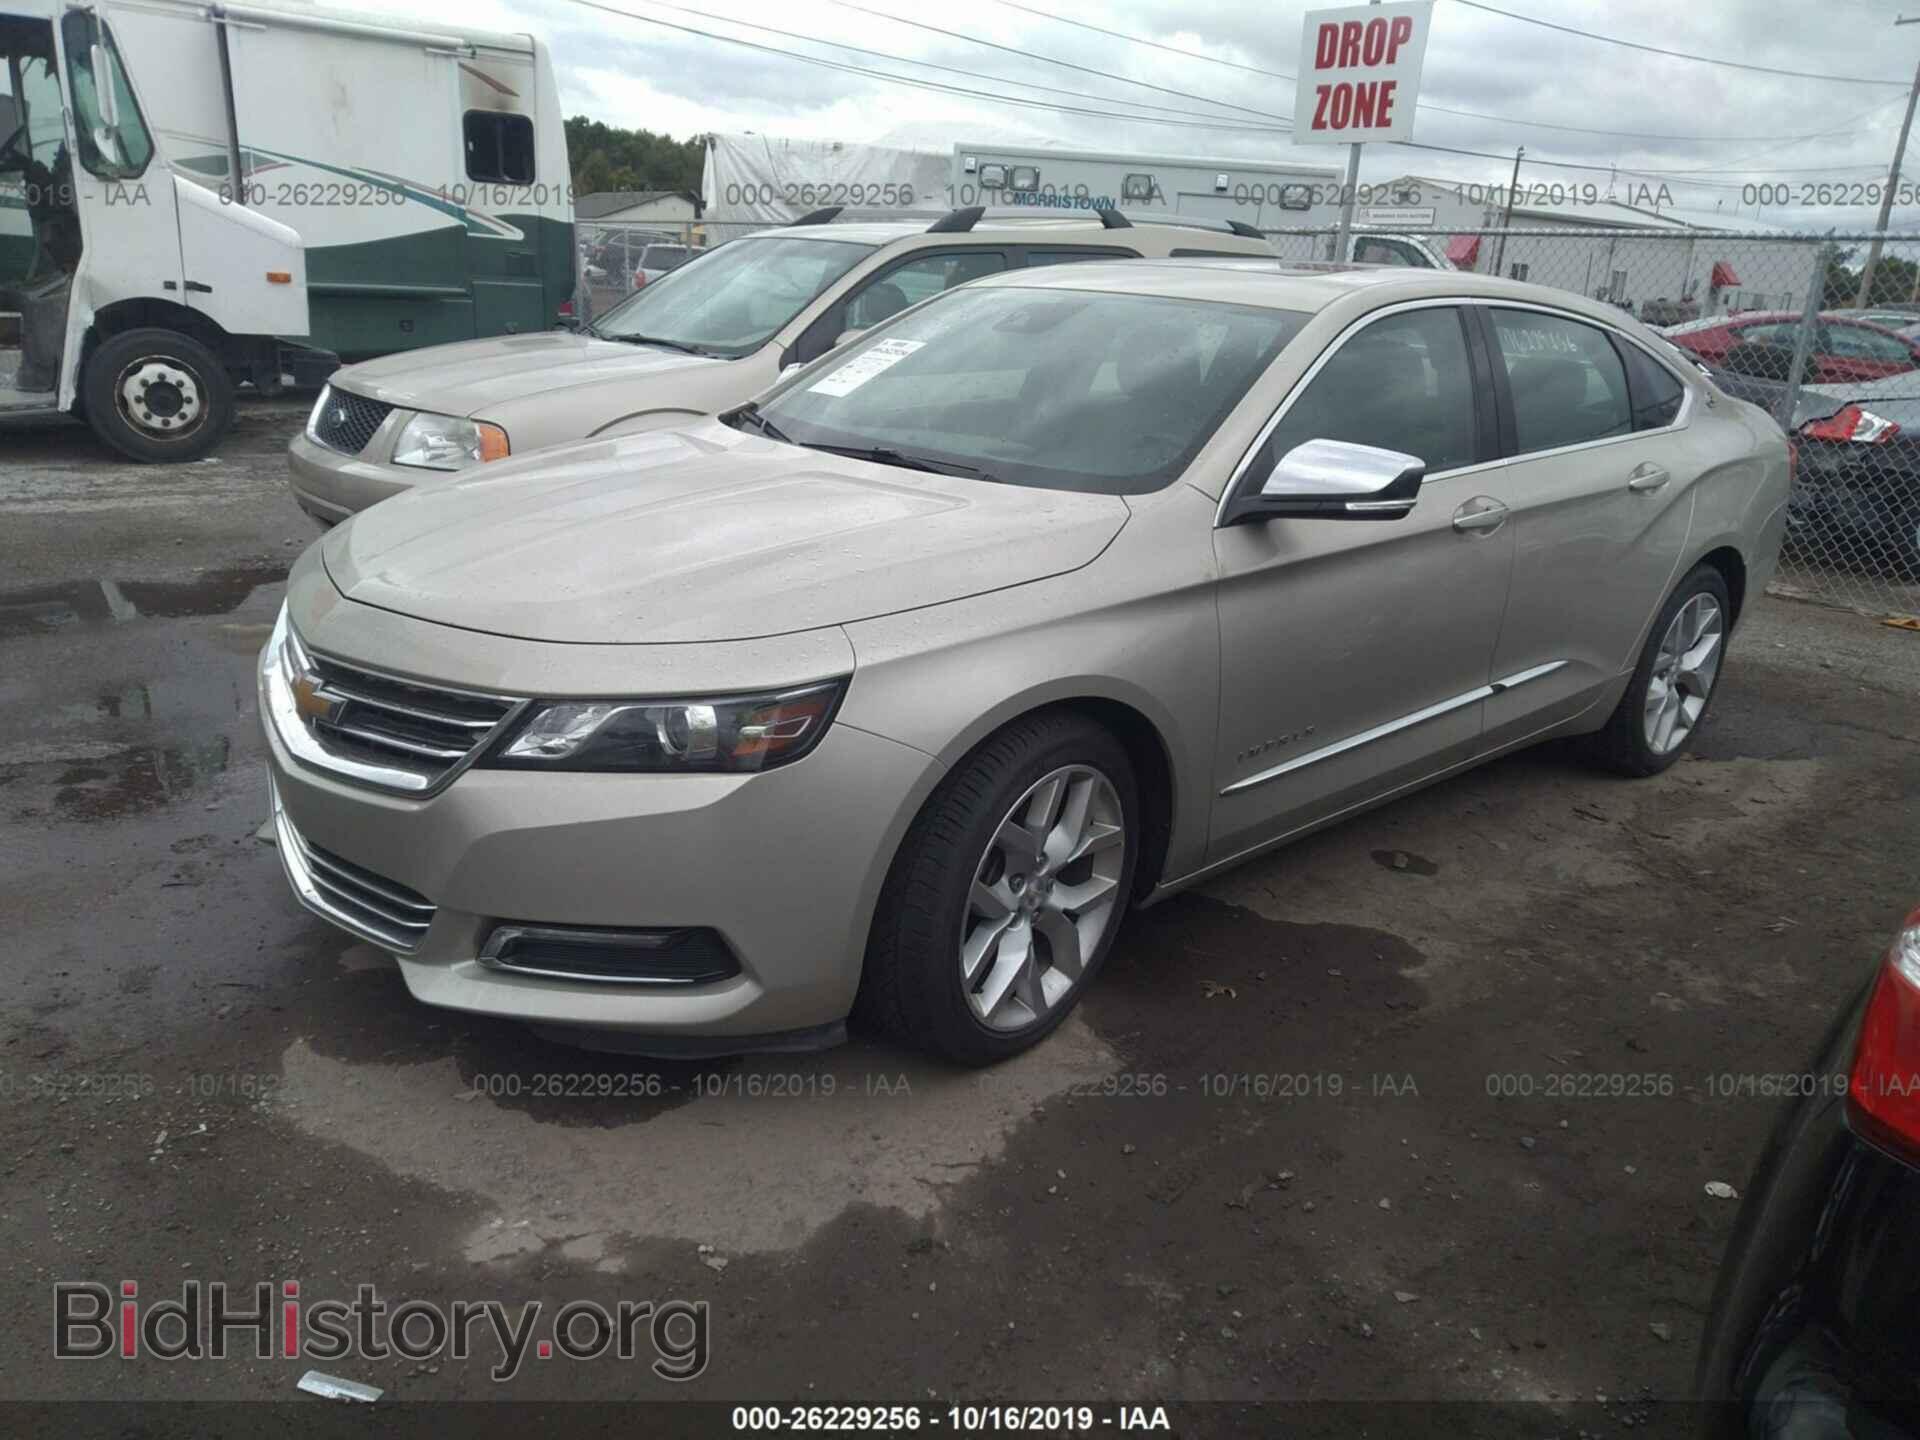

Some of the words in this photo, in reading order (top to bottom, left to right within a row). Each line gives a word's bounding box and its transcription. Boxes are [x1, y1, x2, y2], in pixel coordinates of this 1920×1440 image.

[1315, 16, 1412, 70] DROP
[1311, 80, 1397, 130] ZONE
[1014, 192, 1117, 210] MORRISTOWN
